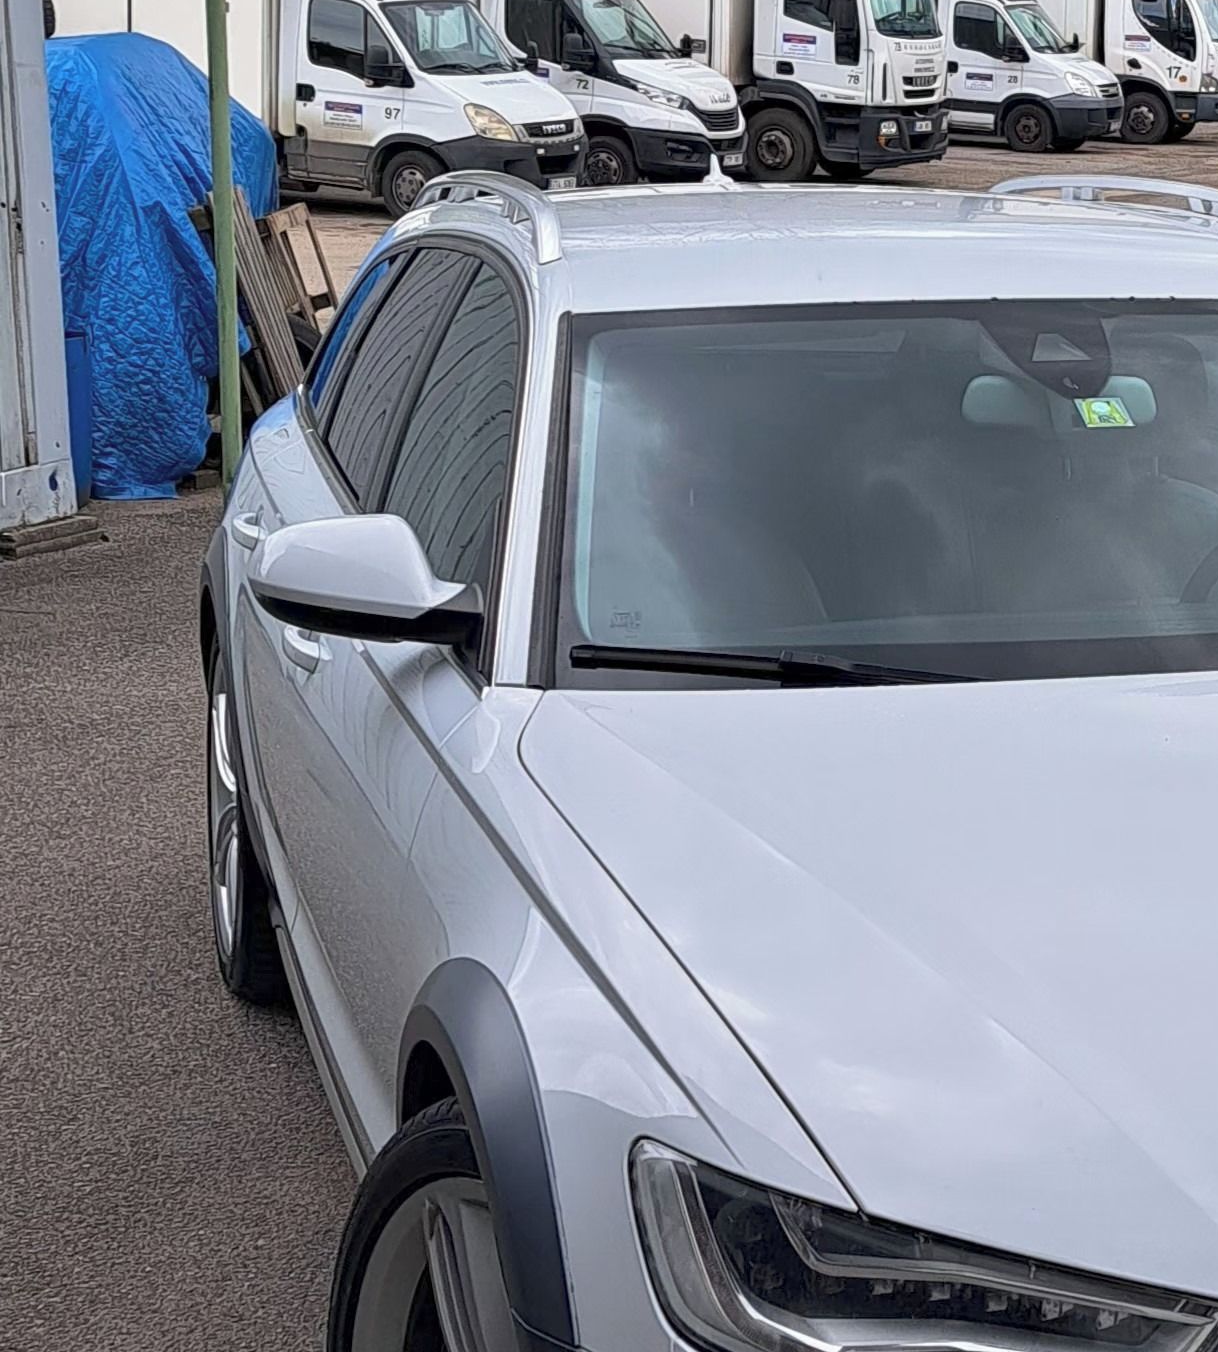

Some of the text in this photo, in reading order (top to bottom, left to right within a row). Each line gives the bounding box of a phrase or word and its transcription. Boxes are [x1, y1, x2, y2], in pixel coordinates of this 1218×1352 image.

[1166, 66, 1181, 79] 17
[575, 78, 589, 90] 72
[847, 74, 861, 85] 78
[1007, 75, 1018, 84] 28
[384, 106, 401, 121] 97
